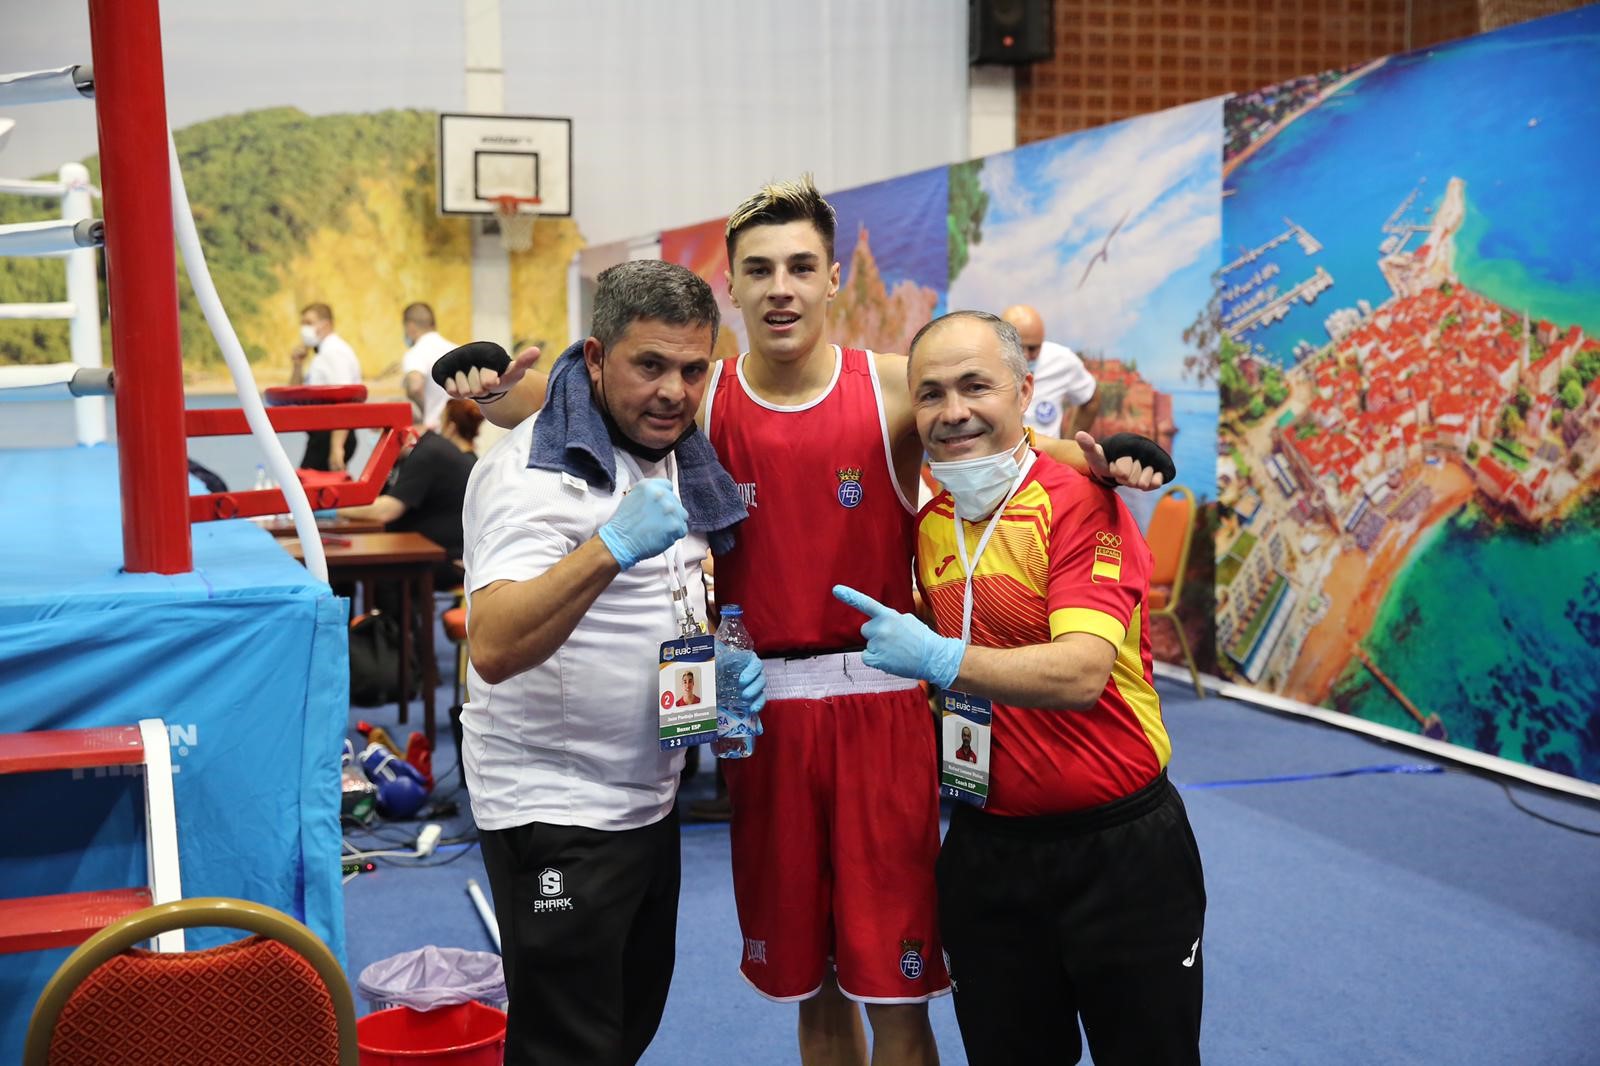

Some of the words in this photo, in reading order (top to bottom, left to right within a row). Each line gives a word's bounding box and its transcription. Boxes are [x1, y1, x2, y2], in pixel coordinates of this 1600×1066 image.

[735, 482, 758, 508] ONE
[718, 716, 729, 726] SA
[691, 723, 701, 731] ESP
[534, 897, 572, 909] SHARK
